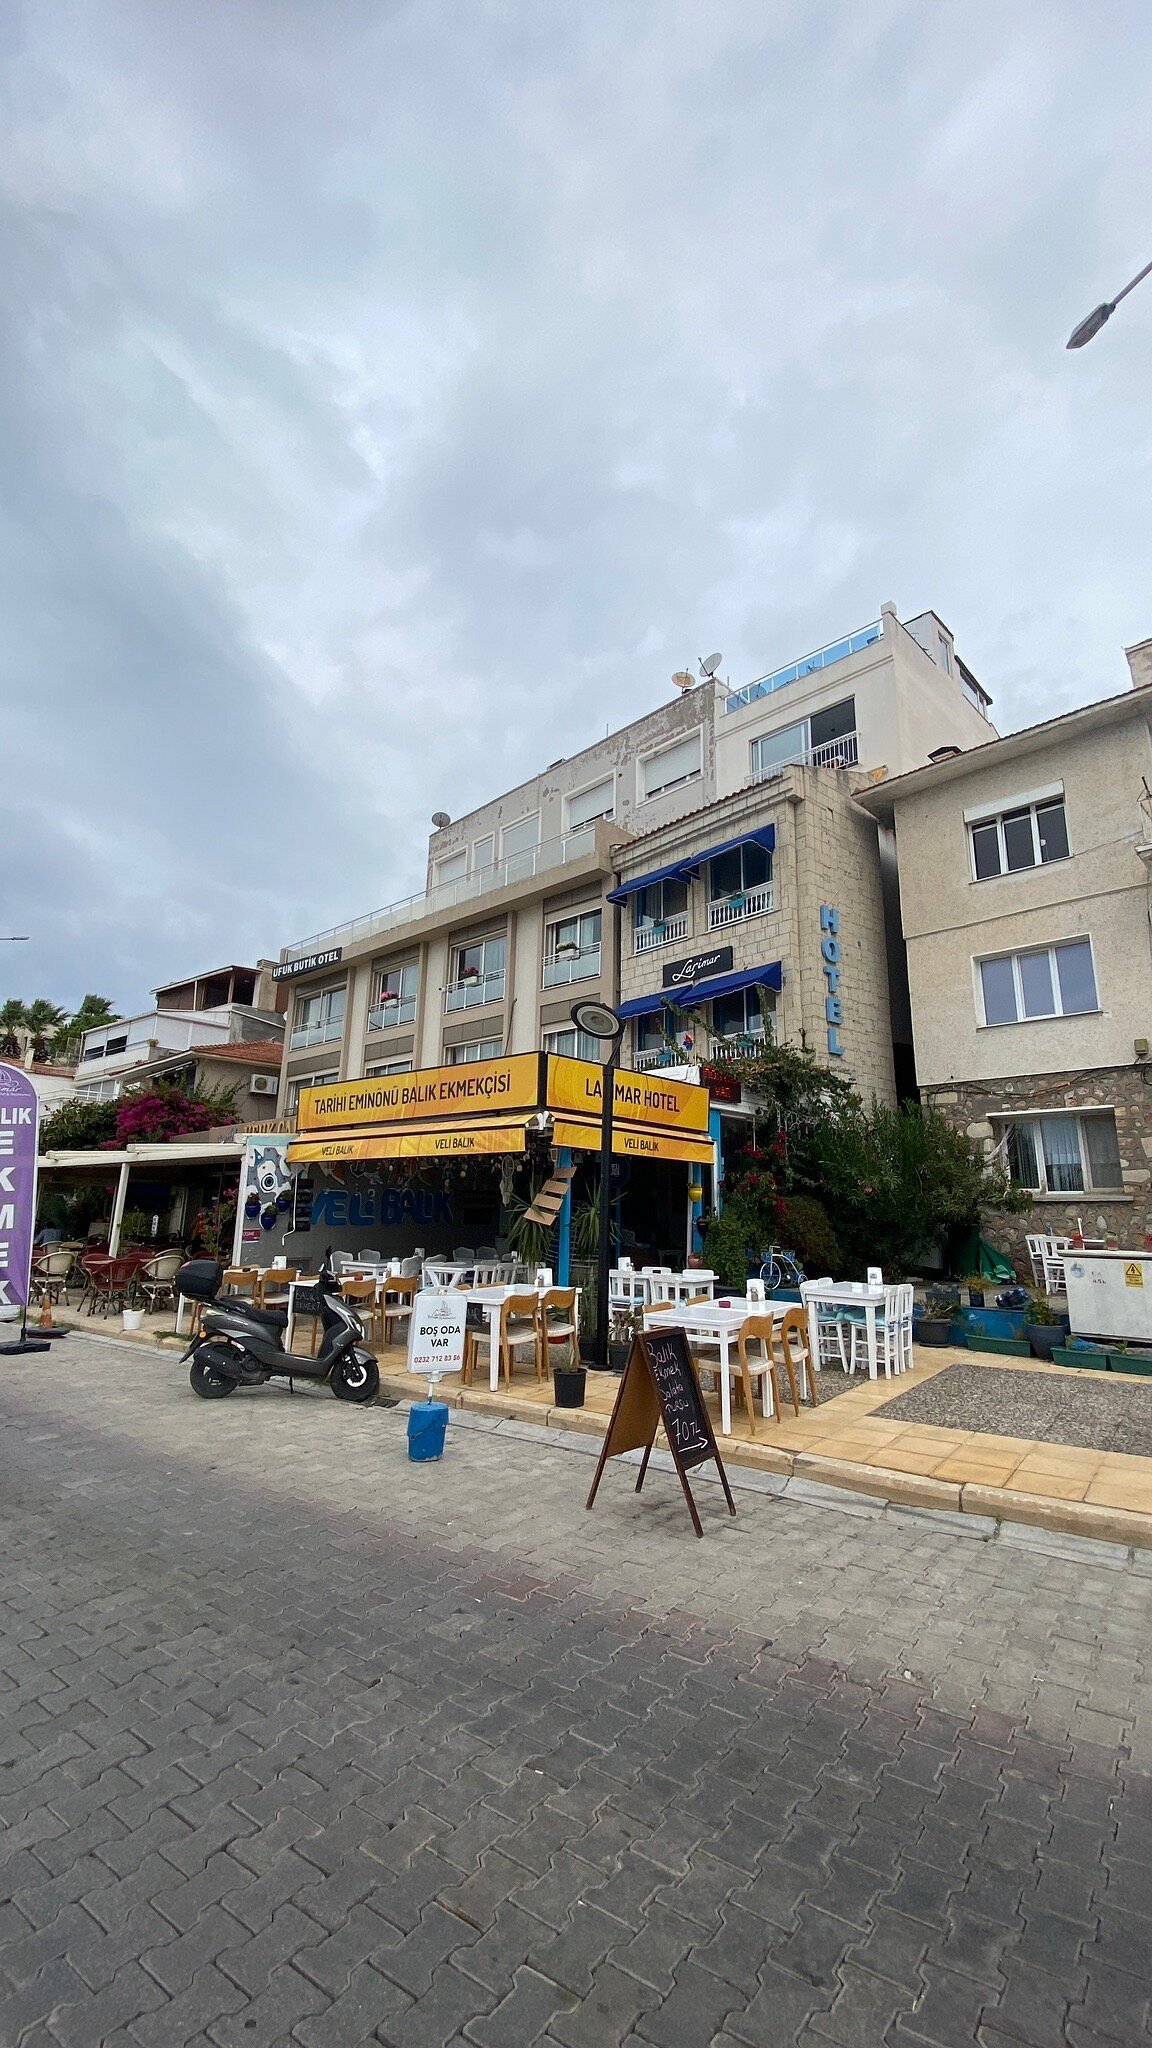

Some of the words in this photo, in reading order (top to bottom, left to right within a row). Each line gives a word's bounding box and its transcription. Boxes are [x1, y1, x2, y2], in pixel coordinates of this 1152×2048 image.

[273, 964, 293, 977] UFUK
[293, 956, 317, 971] BUTİK
[318, 950, 338, 964] OTEL
[672, 954, 721, 982] Larimar
[820, 904, 844, 1056] HOTEL
[315, 1092, 346, 1115] TARİHİ
[349, 1086, 398, 1111] EMİNÖNÜ
[401, 1084, 436, 1105] BALIK
[439, 1069, 511, 1099] EKMEKÇİSİ
[586, 1078, 641, 1105] LAMAR
[645, 1091, 680, 1112] HOTEL
[336, 1144, 353, 1155] BALIK
[434, 1137, 451, 1149] VELİ
[452, 1137, 475, 1149] BALIK
[624, 1136, 640, 1149] VELİ
[640, 1139, 659, 1152] BALIK
[420, 1326, 438, 1337] BOŞ
[440, 1325, 461, 1335] ODA
[430, 1338, 449, 1347] VAR
